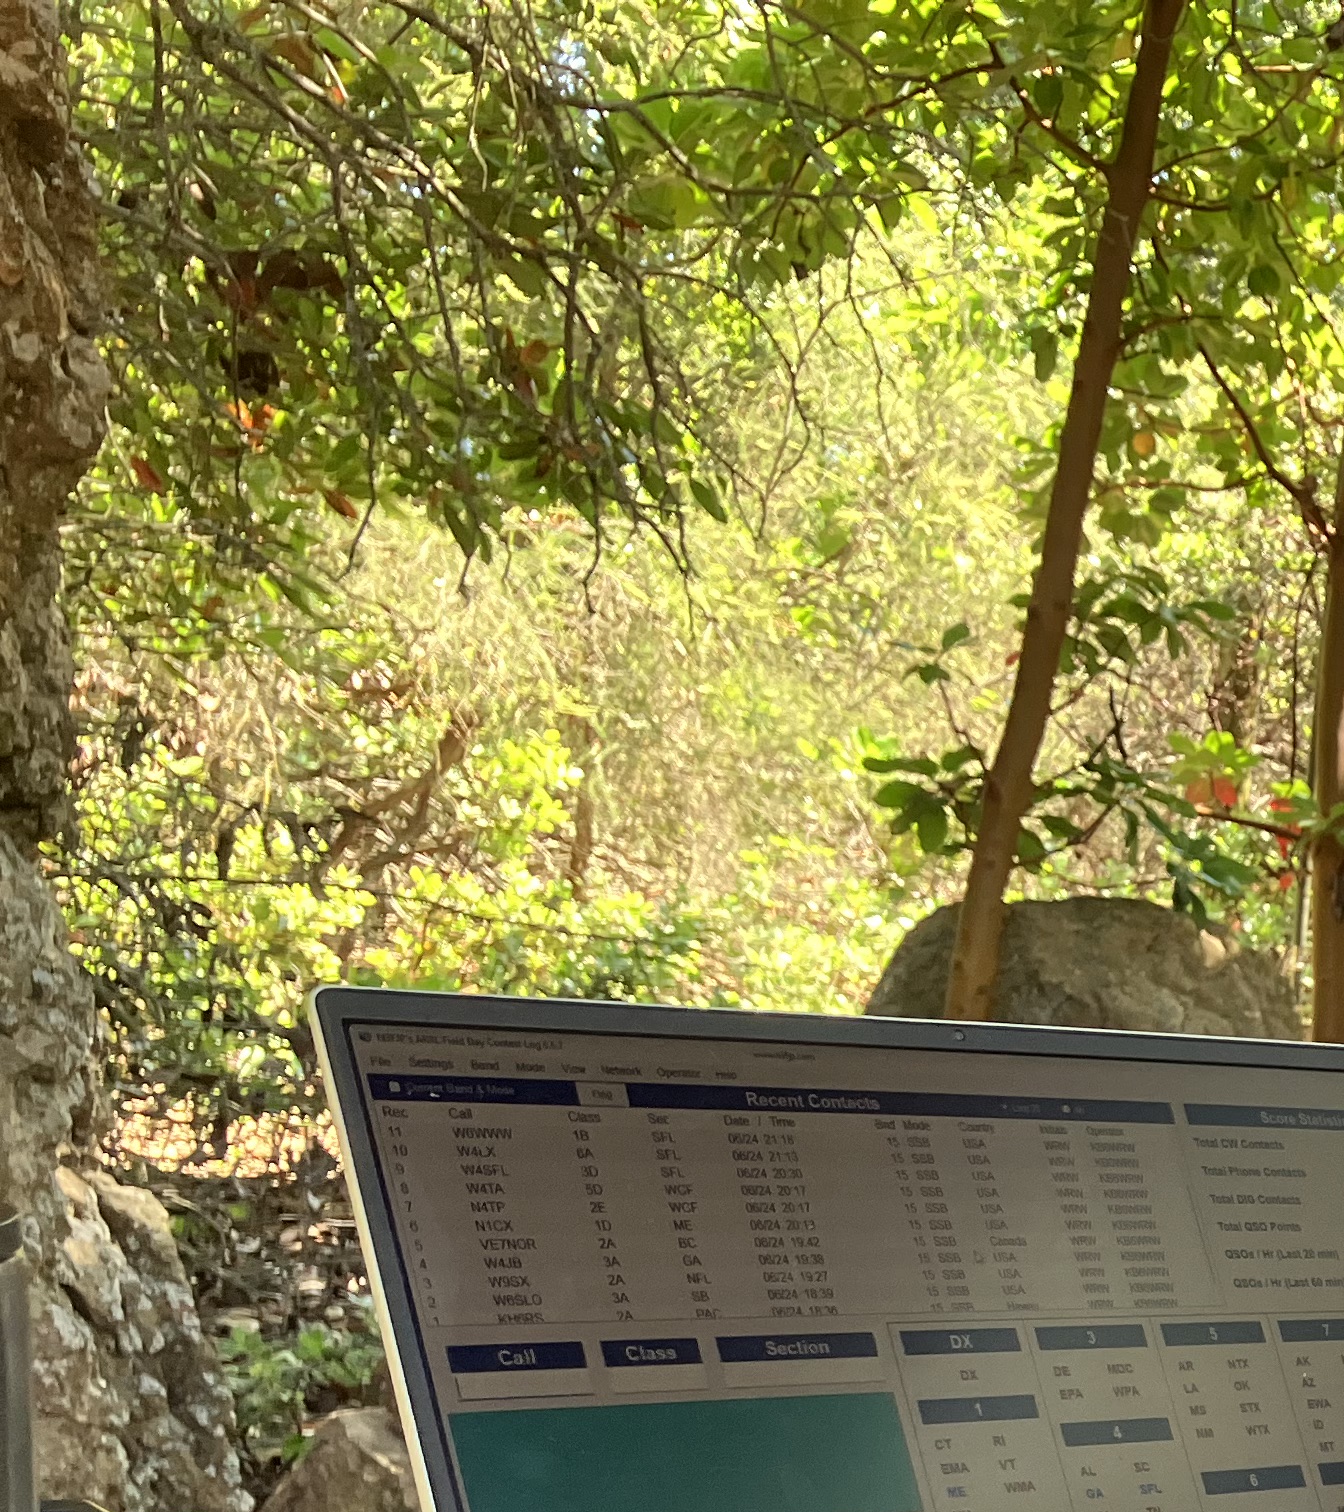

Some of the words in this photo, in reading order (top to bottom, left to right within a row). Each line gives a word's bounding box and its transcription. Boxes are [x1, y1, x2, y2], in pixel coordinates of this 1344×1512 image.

[746, 1092, 804, 1107] Recent
[808, 1095, 880, 1111] Contacts
[1260, 1111, 1296, 1125] Score
[673, 1219, 693, 1231] ME
[598, 1237, 617, 1250] 2A
[607, 1274, 626, 1286] 2A
[1209, 1327, 1218, 1341] 5
[1321, 1324, 1329, 1336] 7
[950, 1334, 973, 1349] DX
[1087, 1331, 1096, 1344] 3
[625, 1345, 677, 1362] Class
[766, 1339, 830, 1356] Section
[499, 1349, 536, 1366] Call
[974, 1403, 983, 1416] 1
[1114, 1426, 1122, 1439] 4
[1250, 1474, 1258, 1487] 6
